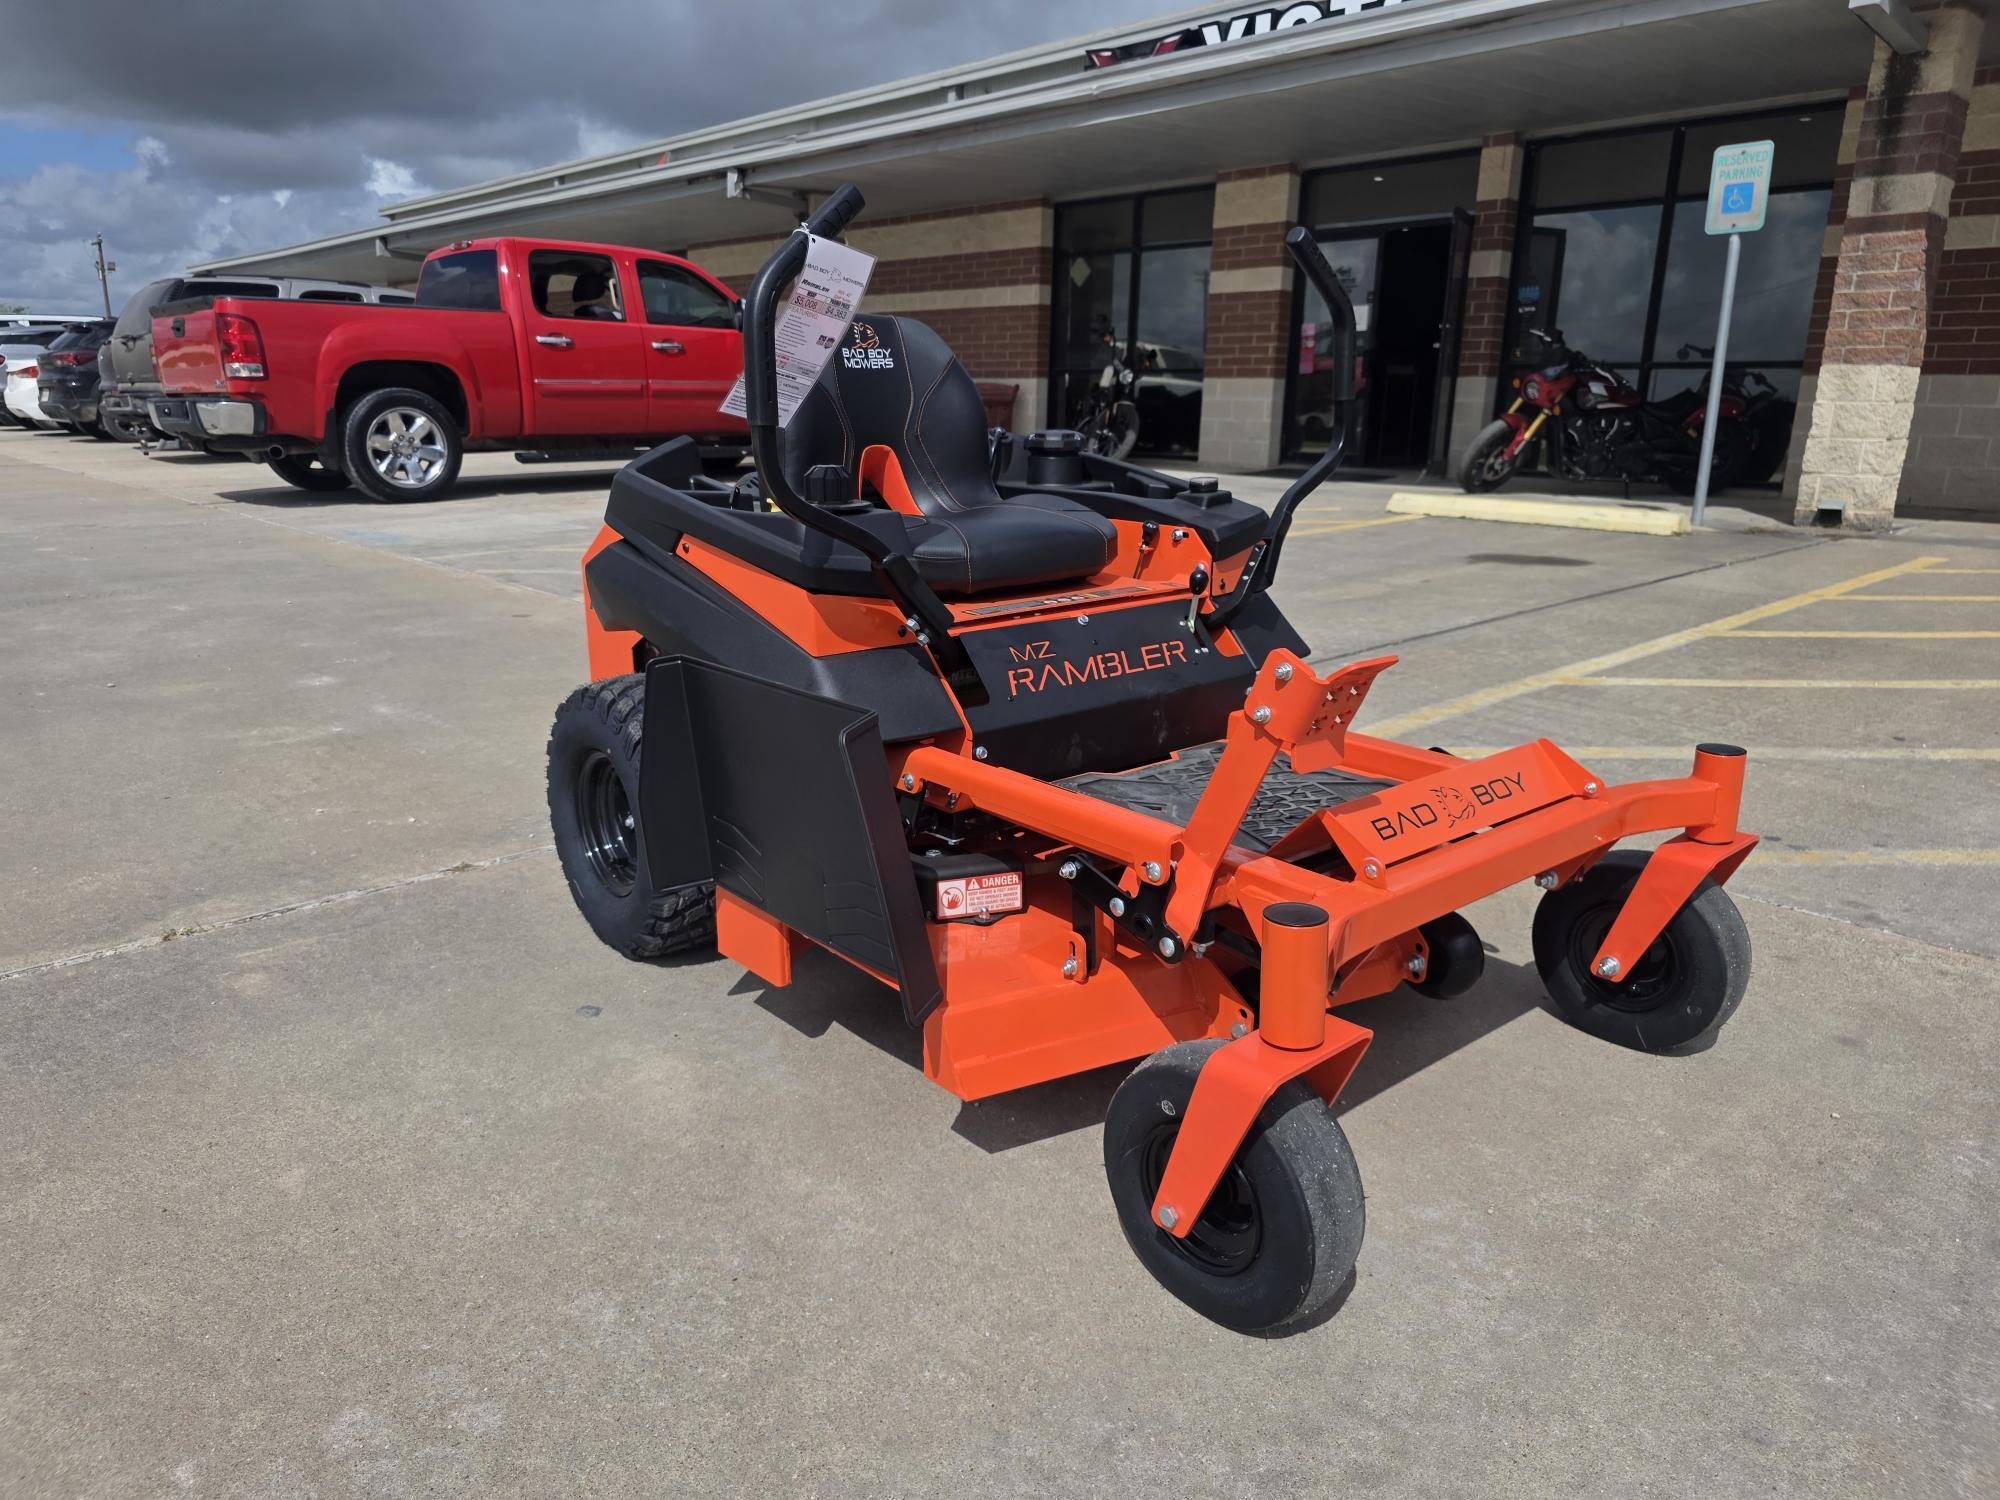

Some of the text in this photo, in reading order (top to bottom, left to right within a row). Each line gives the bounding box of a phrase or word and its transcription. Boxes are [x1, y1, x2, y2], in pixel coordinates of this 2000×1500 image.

[1716, 151, 1769, 166] RESERVED
[1719, 167, 1763, 180] PARKING
[842, 348, 891, 358] BAD BOY
[844, 358, 894, 369] MOWERS
[1008, 640, 1056, 663] MZ
[1008, 640, 1188, 696] RAMBLER
[1370, 772, 1525, 841] BAD BOY
[982, 874, 1019, 888] DANGER
